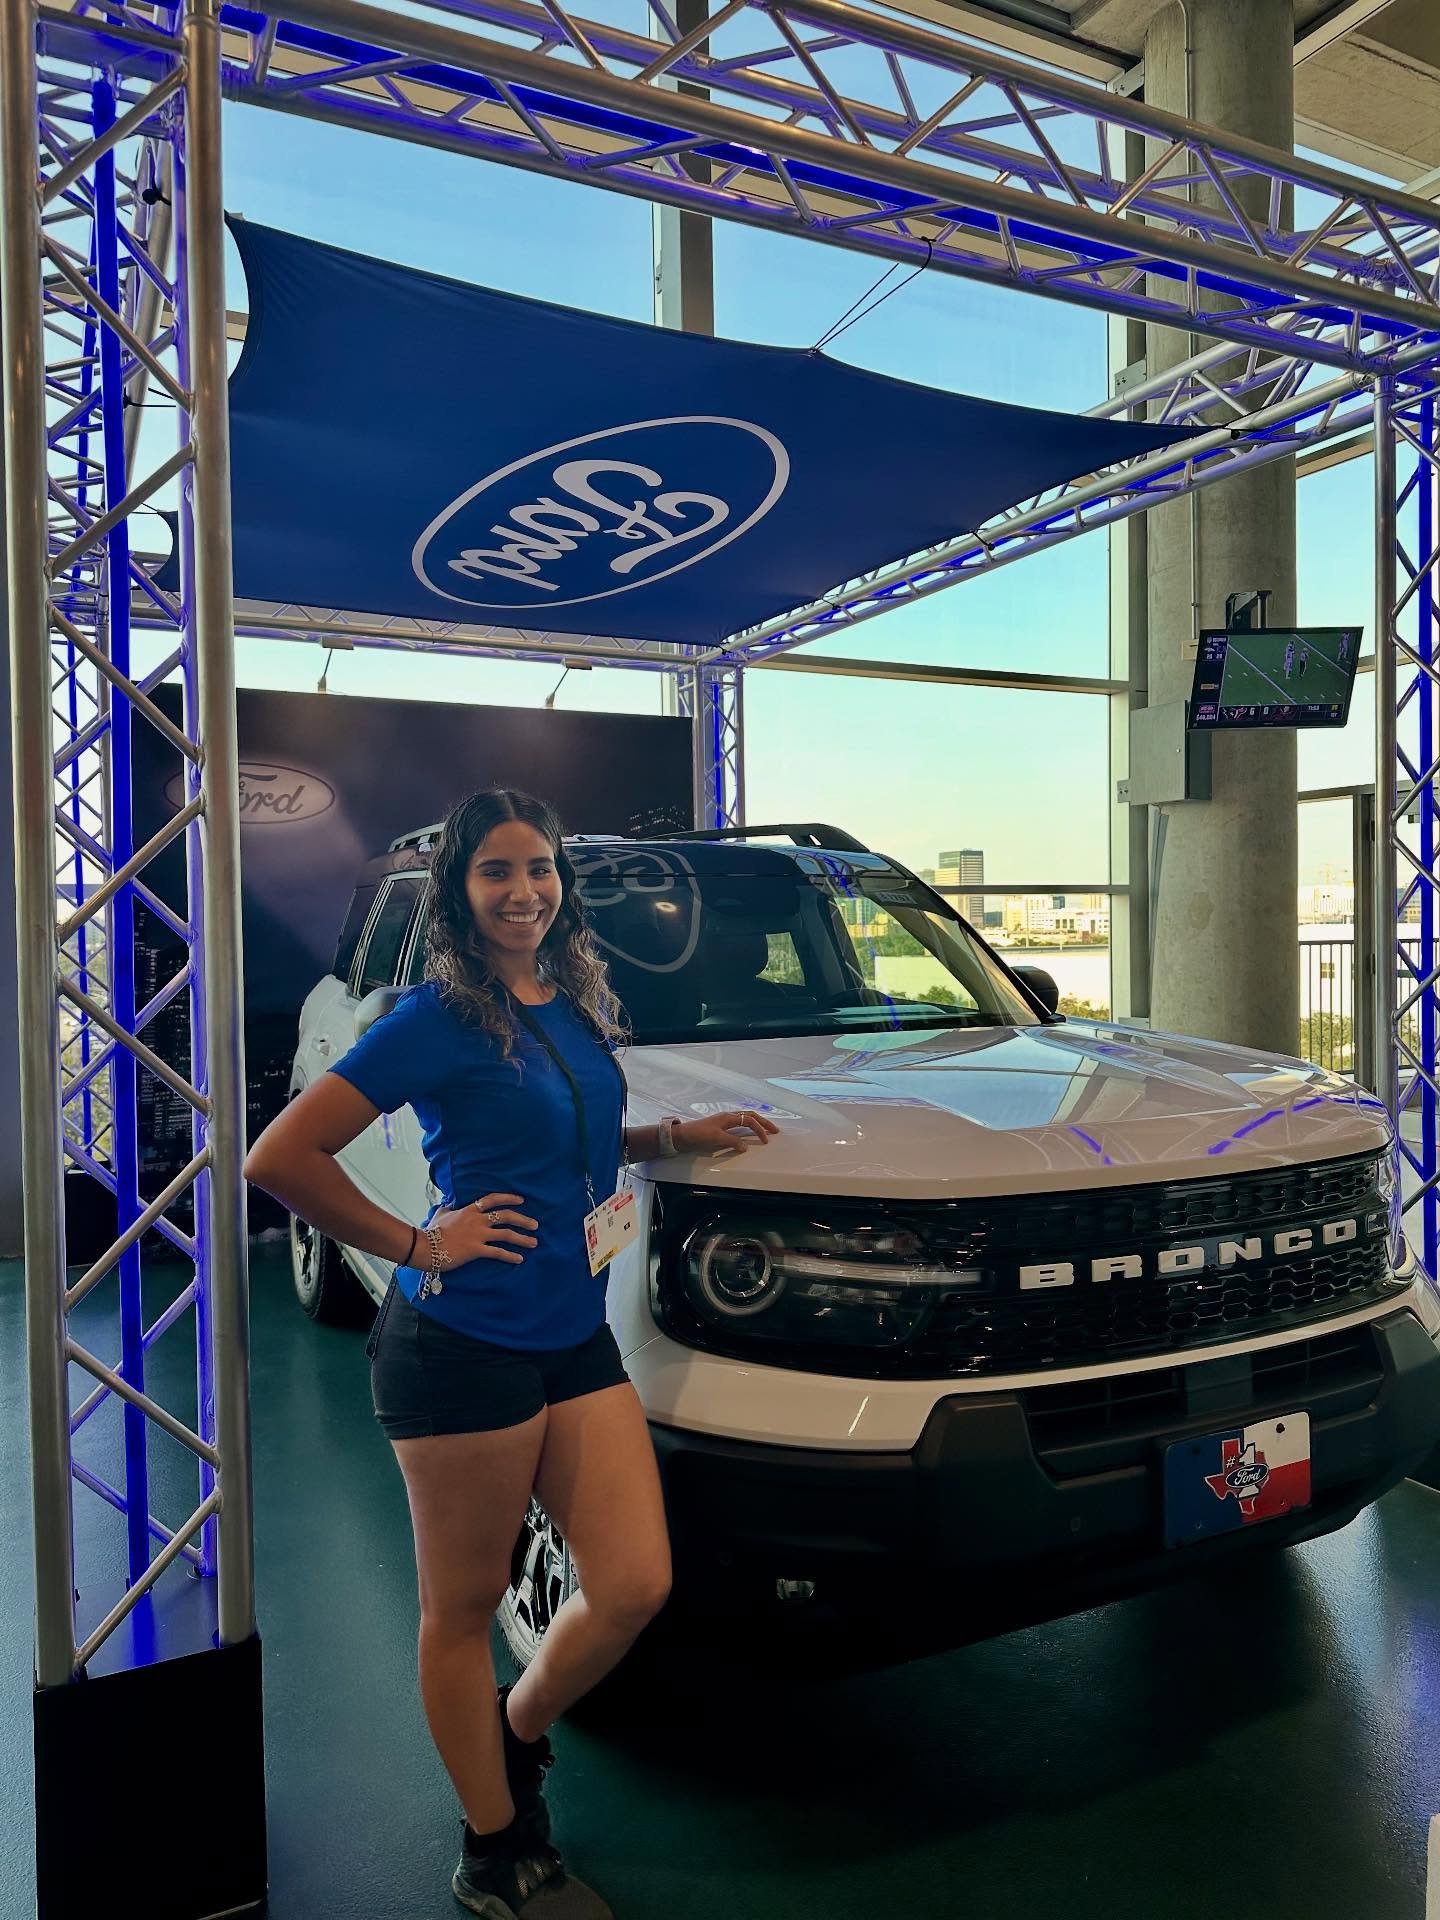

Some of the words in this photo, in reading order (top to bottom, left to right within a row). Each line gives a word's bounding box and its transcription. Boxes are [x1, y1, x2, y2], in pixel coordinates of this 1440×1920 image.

[447, 459, 730, 591] Ford
[1019, 1219, 1357, 1290] BRONCO
[1234, 1466, 1261, 1485] Ford
